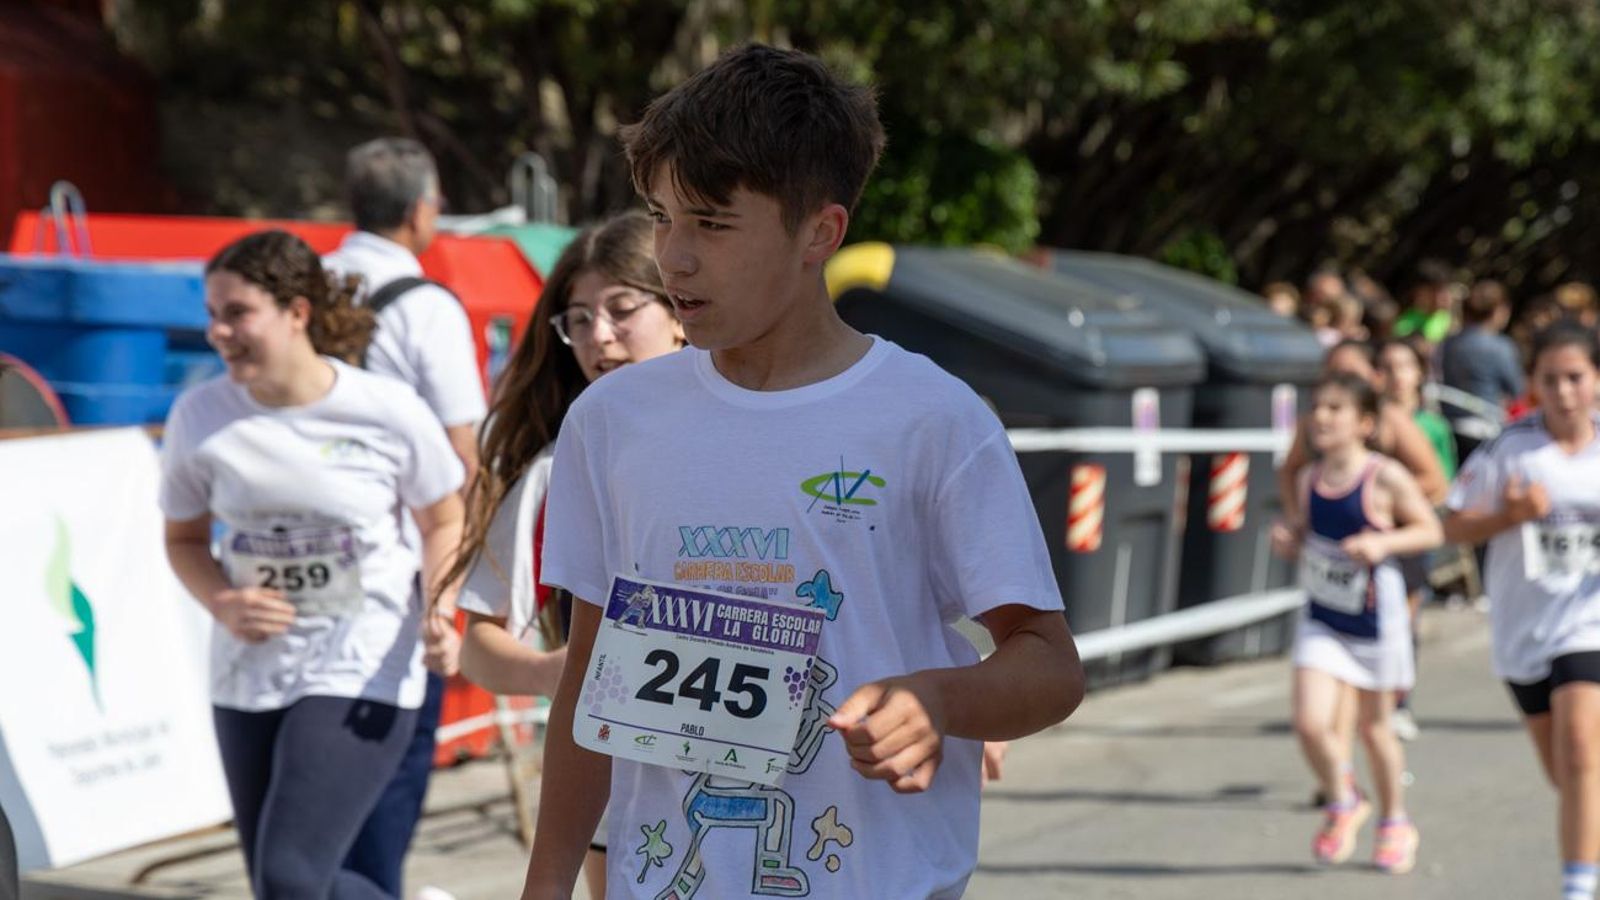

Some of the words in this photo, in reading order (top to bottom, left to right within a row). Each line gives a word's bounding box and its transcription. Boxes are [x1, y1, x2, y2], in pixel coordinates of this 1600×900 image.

[678, 525, 789, 560] XXXVI
[257, 562, 331, 592] 259
[673, 560, 733, 581] CARRERA
[736, 561, 796, 584] ESCOLAR
[646, 592, 716, 632] XXXVI
[717, 603, 769, 624] CARRERA
[771, 612, 822, 634] ESCOLAR
[723, 619, 742, 637] LA
[752, 624, 806, 648] GLORIA
[634, 648, 770, 719] 245
[680, 722, 705, 737] PABLO
